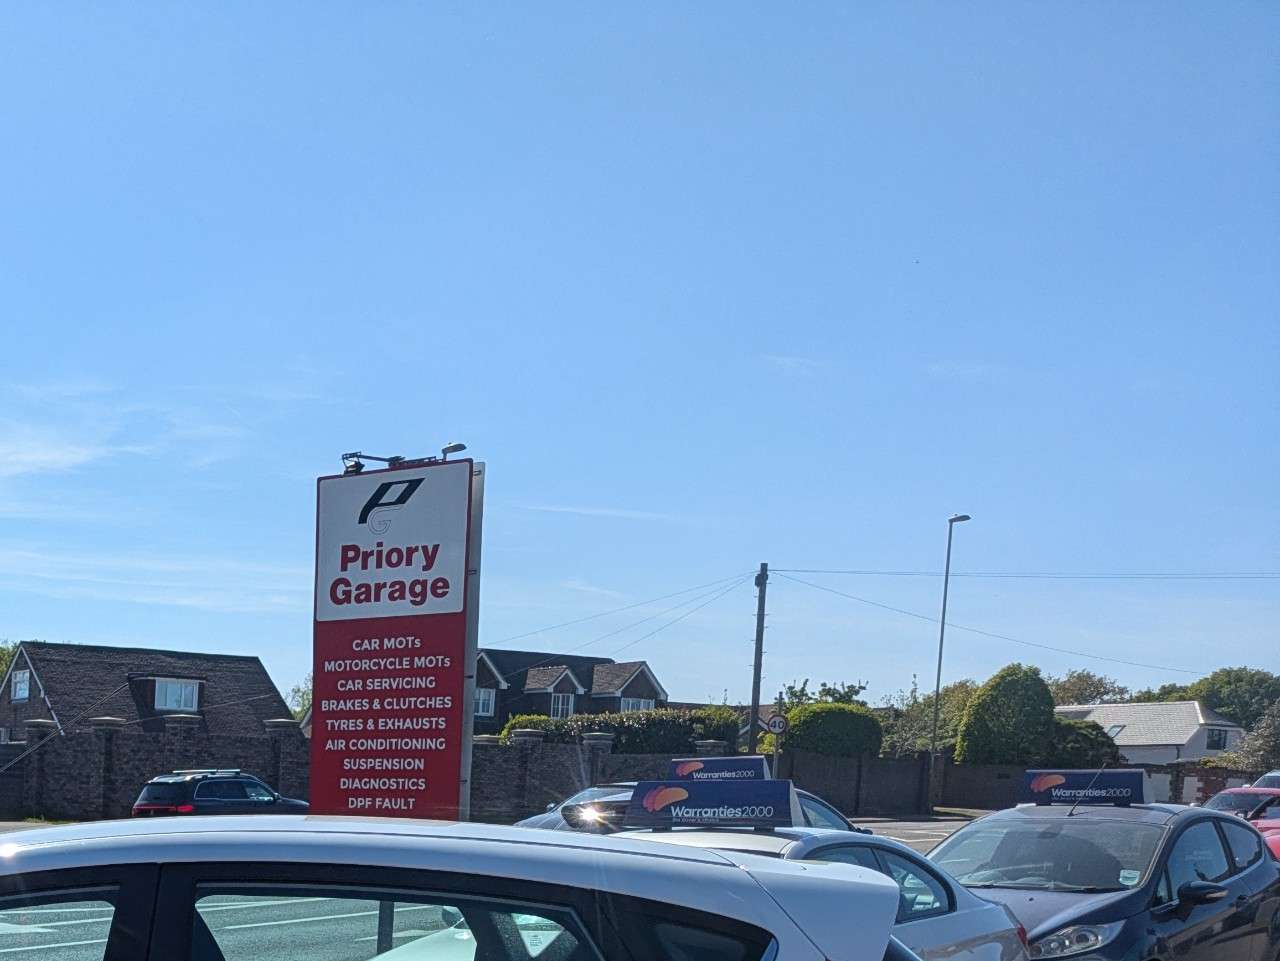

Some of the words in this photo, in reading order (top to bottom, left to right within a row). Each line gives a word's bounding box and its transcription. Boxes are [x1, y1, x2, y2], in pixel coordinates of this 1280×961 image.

[339, 541, 441, 572] Priory
[329, 576, 450, 606] Garage
[352, 638, 380, 651] CAR
[383, 636, 421, 650] MOTs
[324, 656, 410, 673] MOTORCYCLE
[413, 655, 451, 668] MOTs
[337, 679, 363, 692] CAR
[366, 676, 436, 690] SERVICING
[321, 699, 370, 712] BRAKES
[372, 698, 382, 710] &
[384, 696, 452, 710] CLUTCHES
[326, 719, 363, 731] TYRES
[367, 719, 375, 731] &
[378, 717, 446, 730] EXHAUSTS
[770, 720, 785, 730] 40
[325, 739, 346, 751] AIR
[349, 738, 446, 751] CONDITIONING
[343, 758, 425, 771] SUSPENSION
[692, 769, 755, 779] Warranties2000
[340, 777, 426, 790] DIAGNOSTICS
[1051, 787, 1131, 798] Warranties2000
[348, 797, 373, 809] DPF
[375, 797, 416, 810] FAULT
[670, 805, 774, 818] Warranties2000
